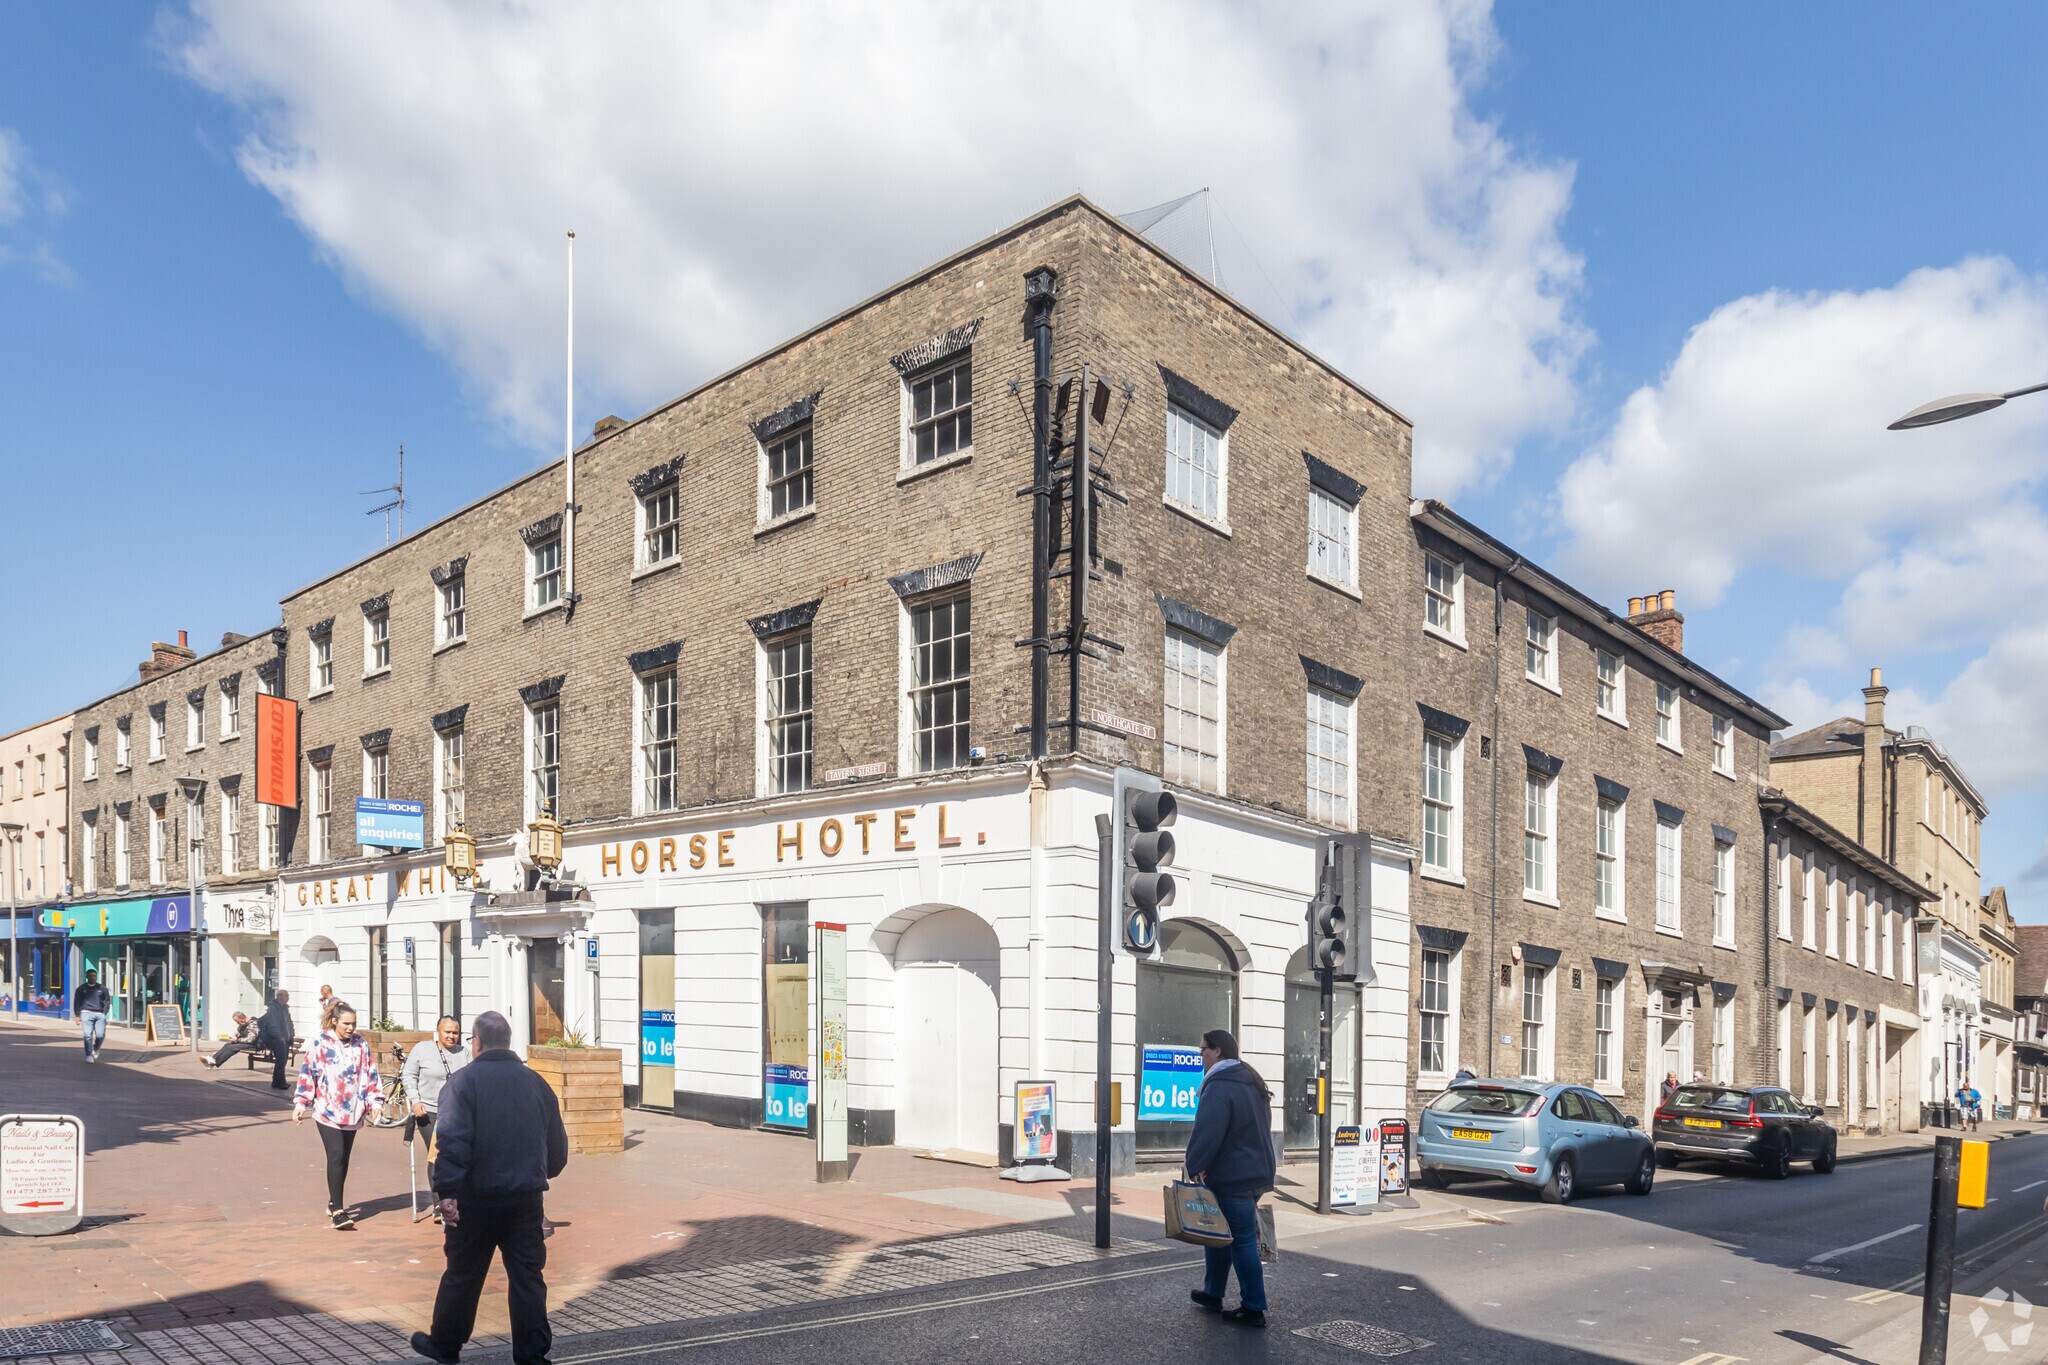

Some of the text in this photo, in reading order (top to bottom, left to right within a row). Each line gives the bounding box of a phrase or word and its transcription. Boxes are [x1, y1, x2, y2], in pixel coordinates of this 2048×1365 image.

[1097, 711, 1151, 736] NORTHGATE ST
[271, 699, 284, 803] COTSWOLD
[830, 765, 881, 779] TAVERN STREET
[359, 816, 375, 827] all
[360, 828, 422, 840] enquiries
[297, 874, 374, 906] GREAT
[395, 860, 484, 897] WHIE
[602, 829, 735, 877] HORSE
[589, 942, 596, 956] P
[643, 1037, 656, 1056] to
[790, 1070, 808, 1080] ROC
[1143, 1084, 1197, 1108] to let
[767, 1096, 783, 1116] to
[3, 1127, 74, 1142] Nails & Beauty
